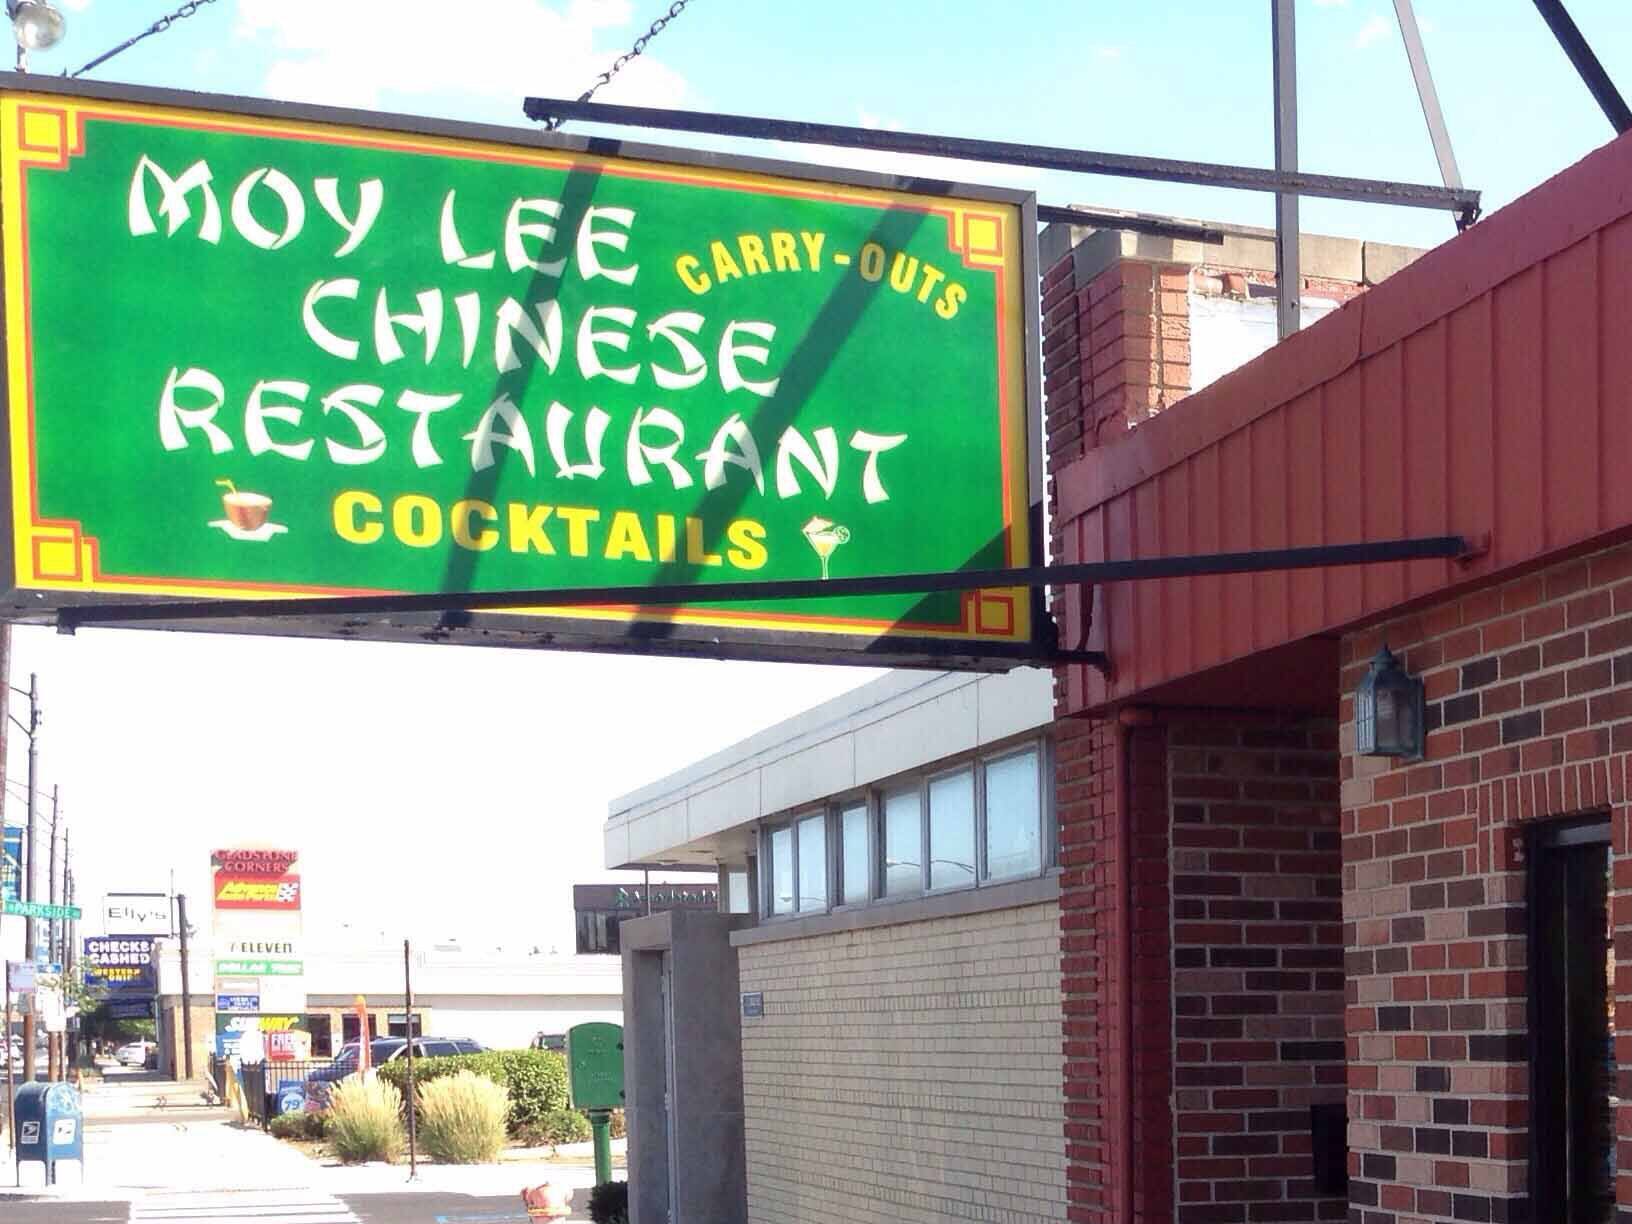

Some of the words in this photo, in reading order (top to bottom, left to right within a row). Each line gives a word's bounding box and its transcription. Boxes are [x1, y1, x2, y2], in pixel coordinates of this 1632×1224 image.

[128, 153, 384, 258] MOY
[438, 188, 640, 286] LEE
[674, 229, 968, 321] CARRY-OUTS
[302, 277, 781, 396] CHINESE
[157, 366, 909, 504] RESTAURANT
[331, 489, 769, 570] COCKTAILS
[223, 861, 289, 873] CORNERS
[14, 903, 74, 918] PARKSIDE
[88, 941, 150, 953] CHECKS
[89, 953, 151, 965] CASHED
